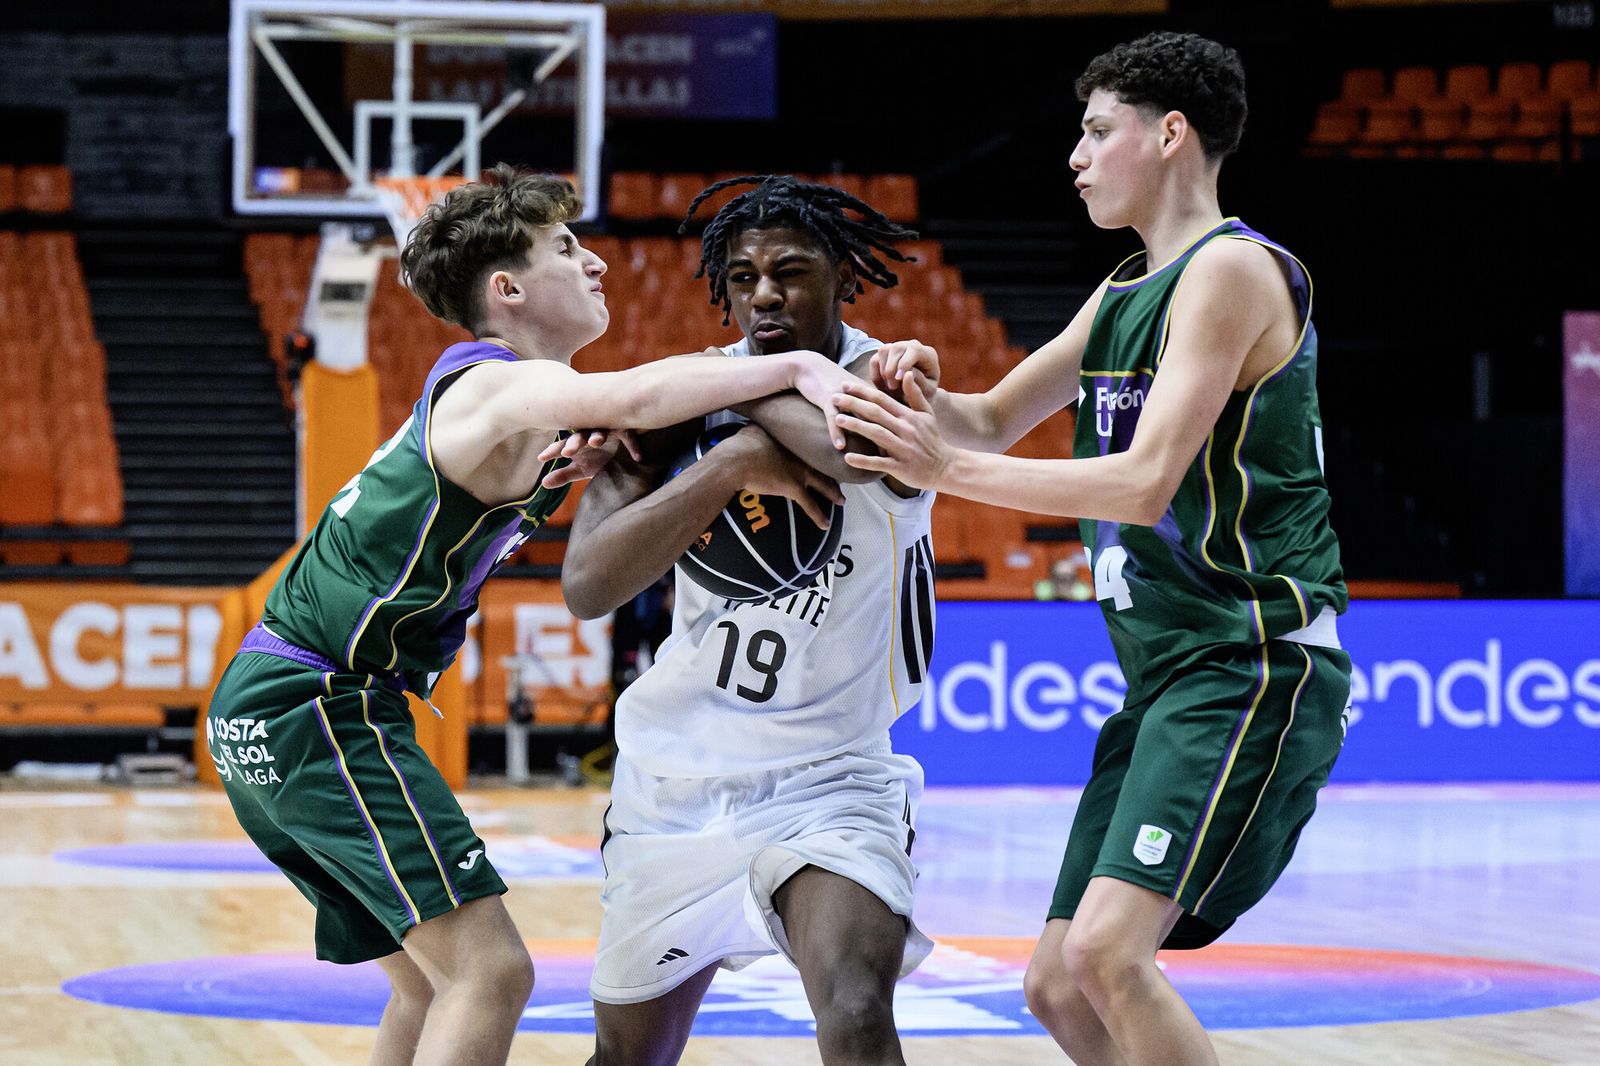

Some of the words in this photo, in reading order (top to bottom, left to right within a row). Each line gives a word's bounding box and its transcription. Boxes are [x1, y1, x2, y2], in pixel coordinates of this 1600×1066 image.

[738, 488, 772, 534] on
[1083, 545, 1134, 612] 4
[716, 620, 787, 703] 19
[919, 639, 1129, 732] des
[1348, 638, 1600, 730] ndes
[237, 744, 275, 765] SOL
